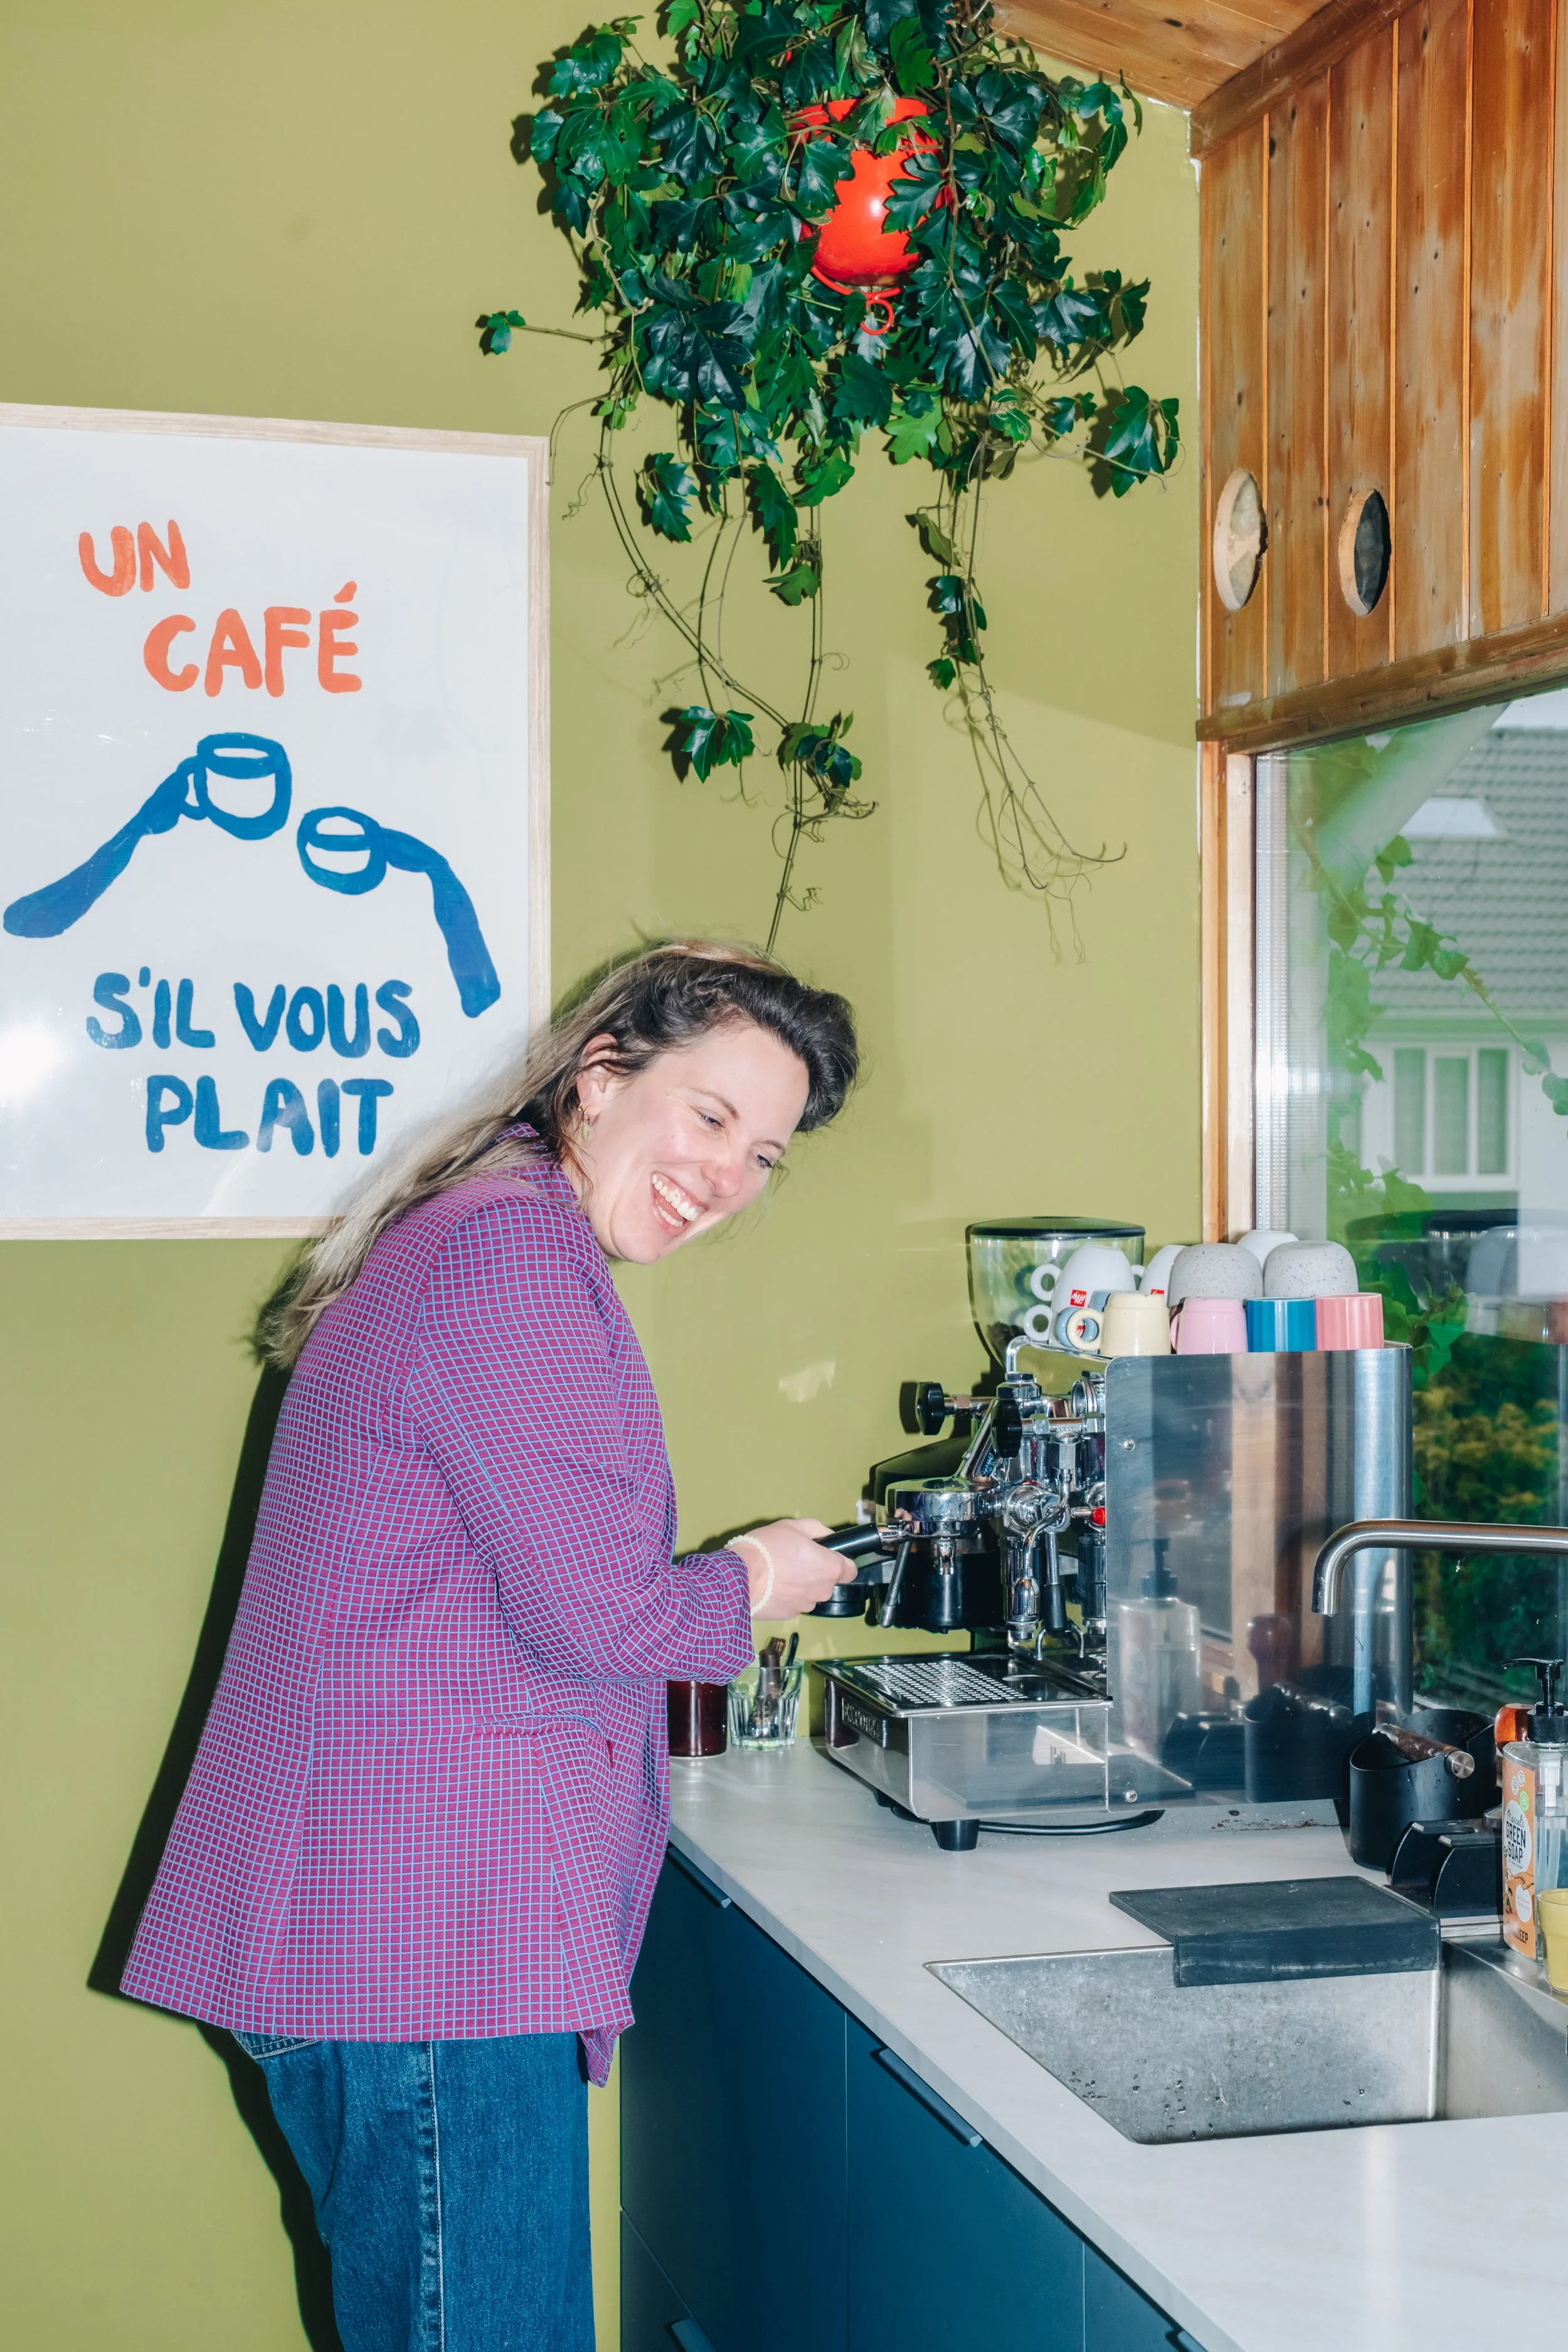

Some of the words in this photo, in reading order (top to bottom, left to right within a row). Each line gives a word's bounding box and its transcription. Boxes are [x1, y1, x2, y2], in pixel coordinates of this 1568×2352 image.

[79, 520, 191, 596] UN
[144, 581, 363, 697] CAFÉ
[87, 967, 216, 1050] S'IL
[233, 979, 421, 1059] VOUS
[146, 1074, 394, 1158] PLAIT
[1071, 1291, 1086, 1305] illy
[1506, 1820, 1526, 1848] GREEN
[1508, 1841, 1523, 1864] SOAP
